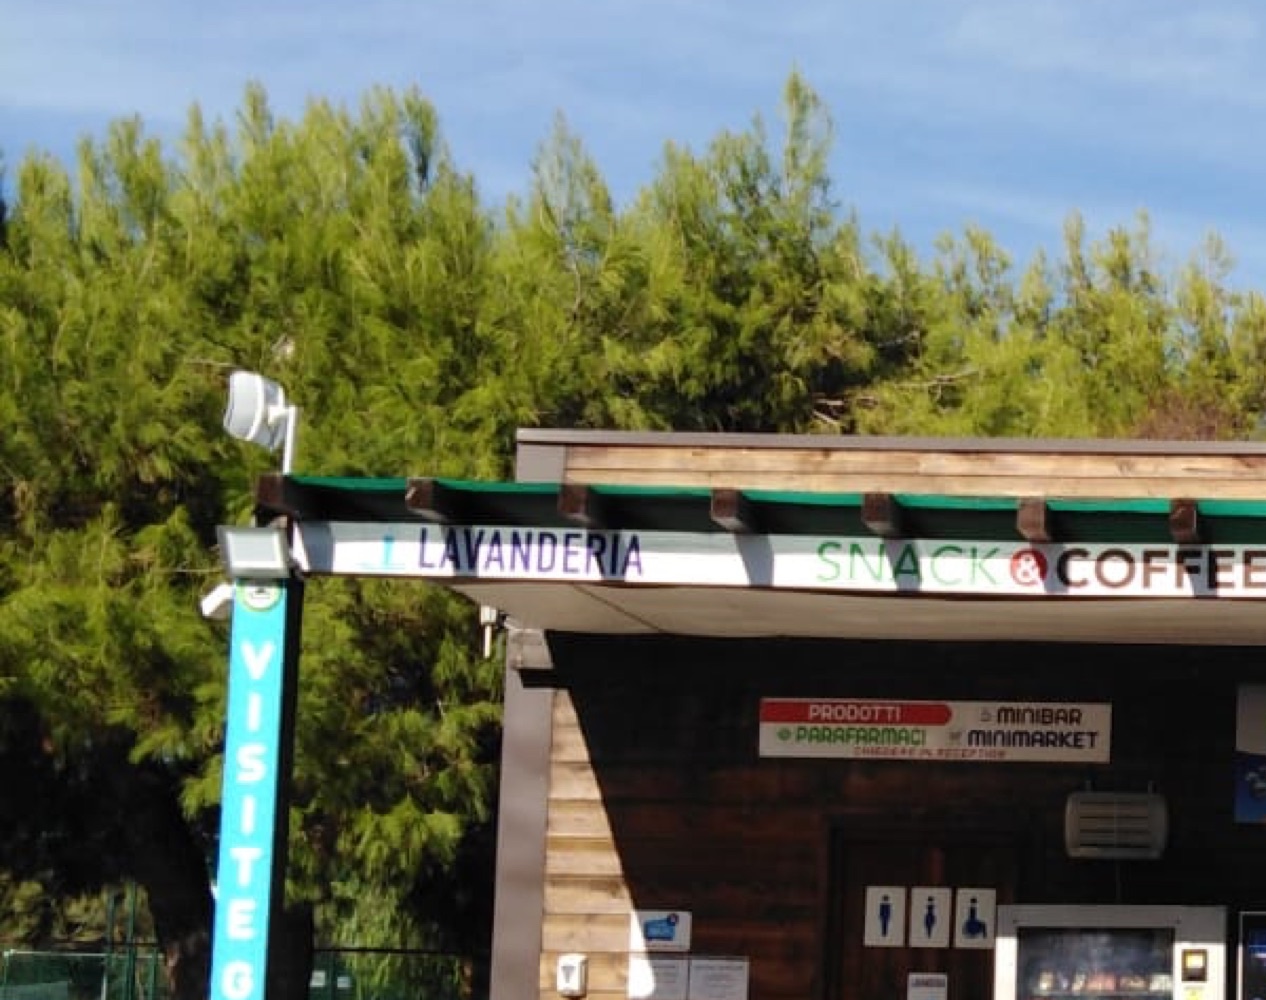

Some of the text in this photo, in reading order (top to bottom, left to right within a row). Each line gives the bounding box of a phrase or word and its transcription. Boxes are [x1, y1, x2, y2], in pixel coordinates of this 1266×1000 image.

[418, 527, 643, 578] LAVANDERIA
[815, 541, 1000, 586] SNACK
[1010, 551, 1046, 586] &
[808, 704, 901, 722] PRODOTTI
[997, 706, 1083, 725] MINIBAR
[795, 727, 927, 747] PARAFARMACI
[967, 729, 1098, 749] MINIMARKET
[225, 638, 277, 942] VISITE
